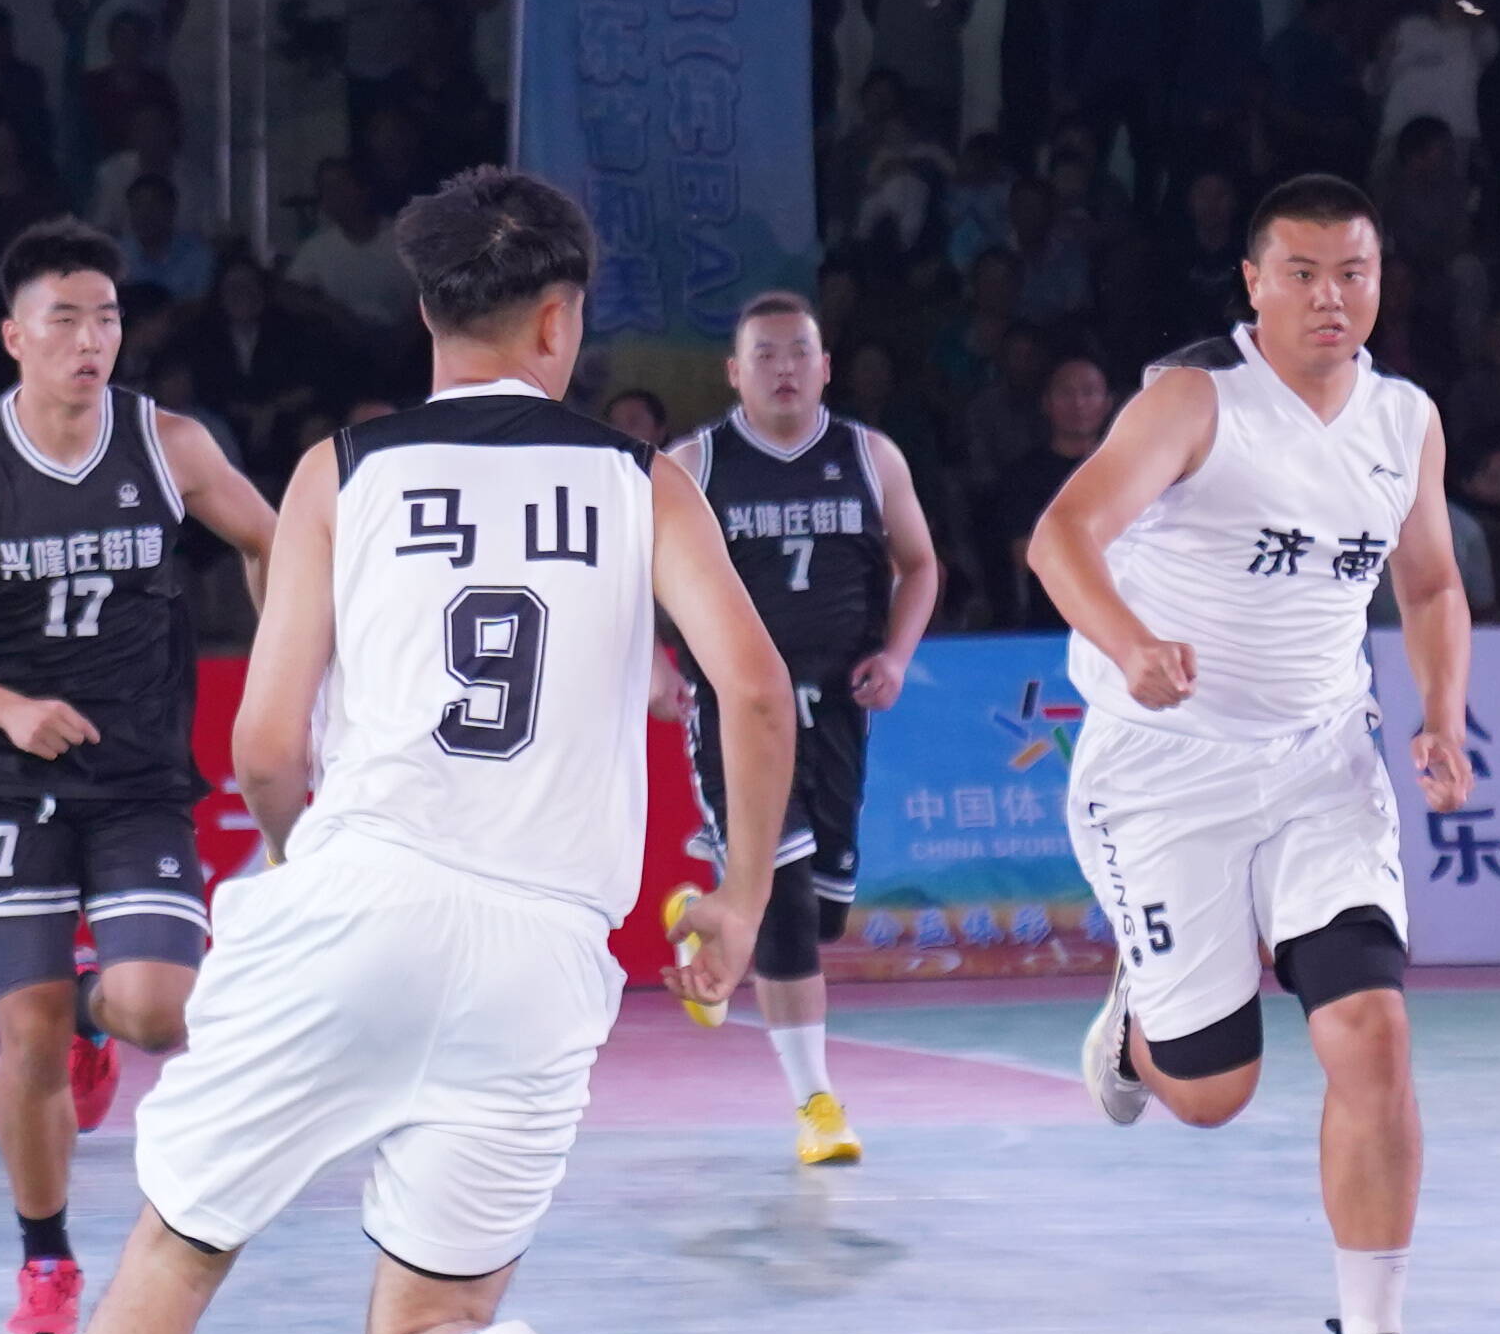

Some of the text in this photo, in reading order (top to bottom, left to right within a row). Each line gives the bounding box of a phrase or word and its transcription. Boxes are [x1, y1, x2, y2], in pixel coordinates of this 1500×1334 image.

[394, 485, 599, 569] 马山
[725, 500, 863, 540] 兴隆庄街道
[782, 539, 814, 592] 7
[1246, 526, 1388, 582] 济南
[43, 575, 114, 638] 17
[431, 584, 549, 762] 9
[1142, 902, 1175, 957] 5
